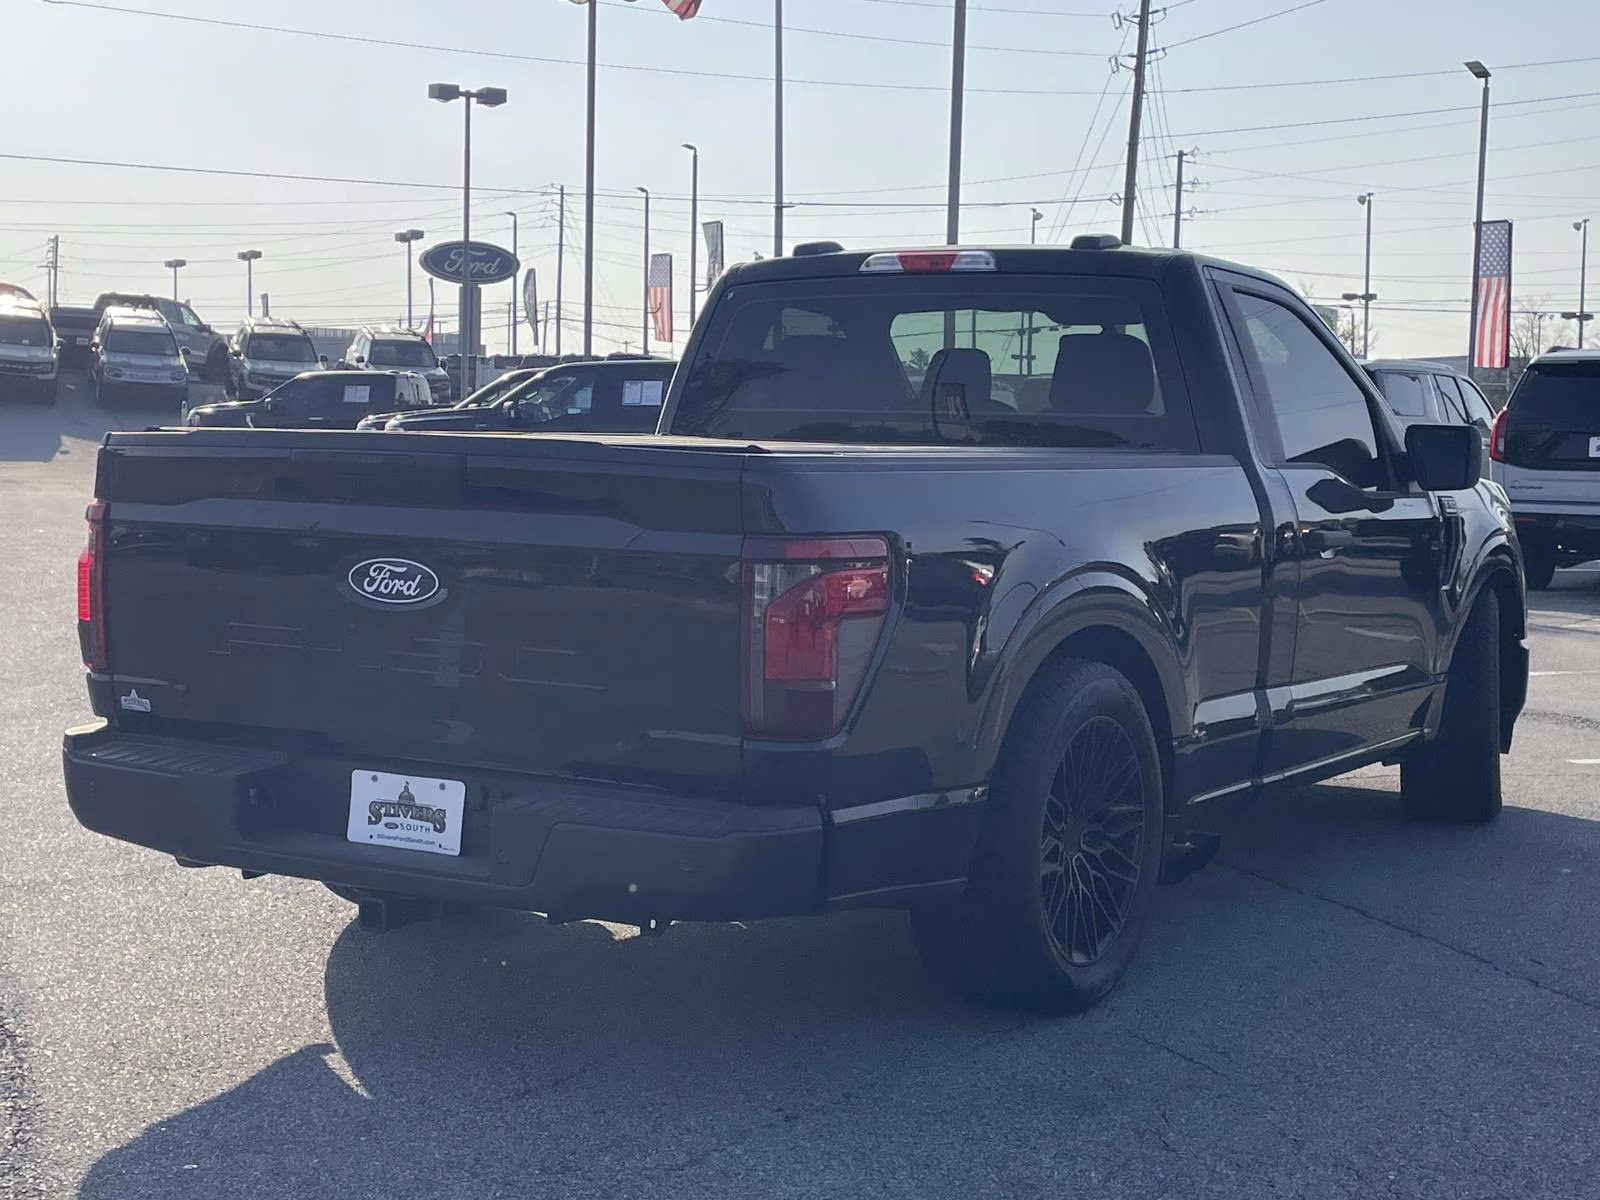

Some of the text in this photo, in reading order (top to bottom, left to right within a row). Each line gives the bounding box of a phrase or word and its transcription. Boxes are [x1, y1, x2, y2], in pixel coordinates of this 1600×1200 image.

[444, 249, 500, 274] Frd
[363, 563, 422, 596] Ford
[367, 800, 447, 834] STIVERS
[400, 823, 431, 833] SOUTH
